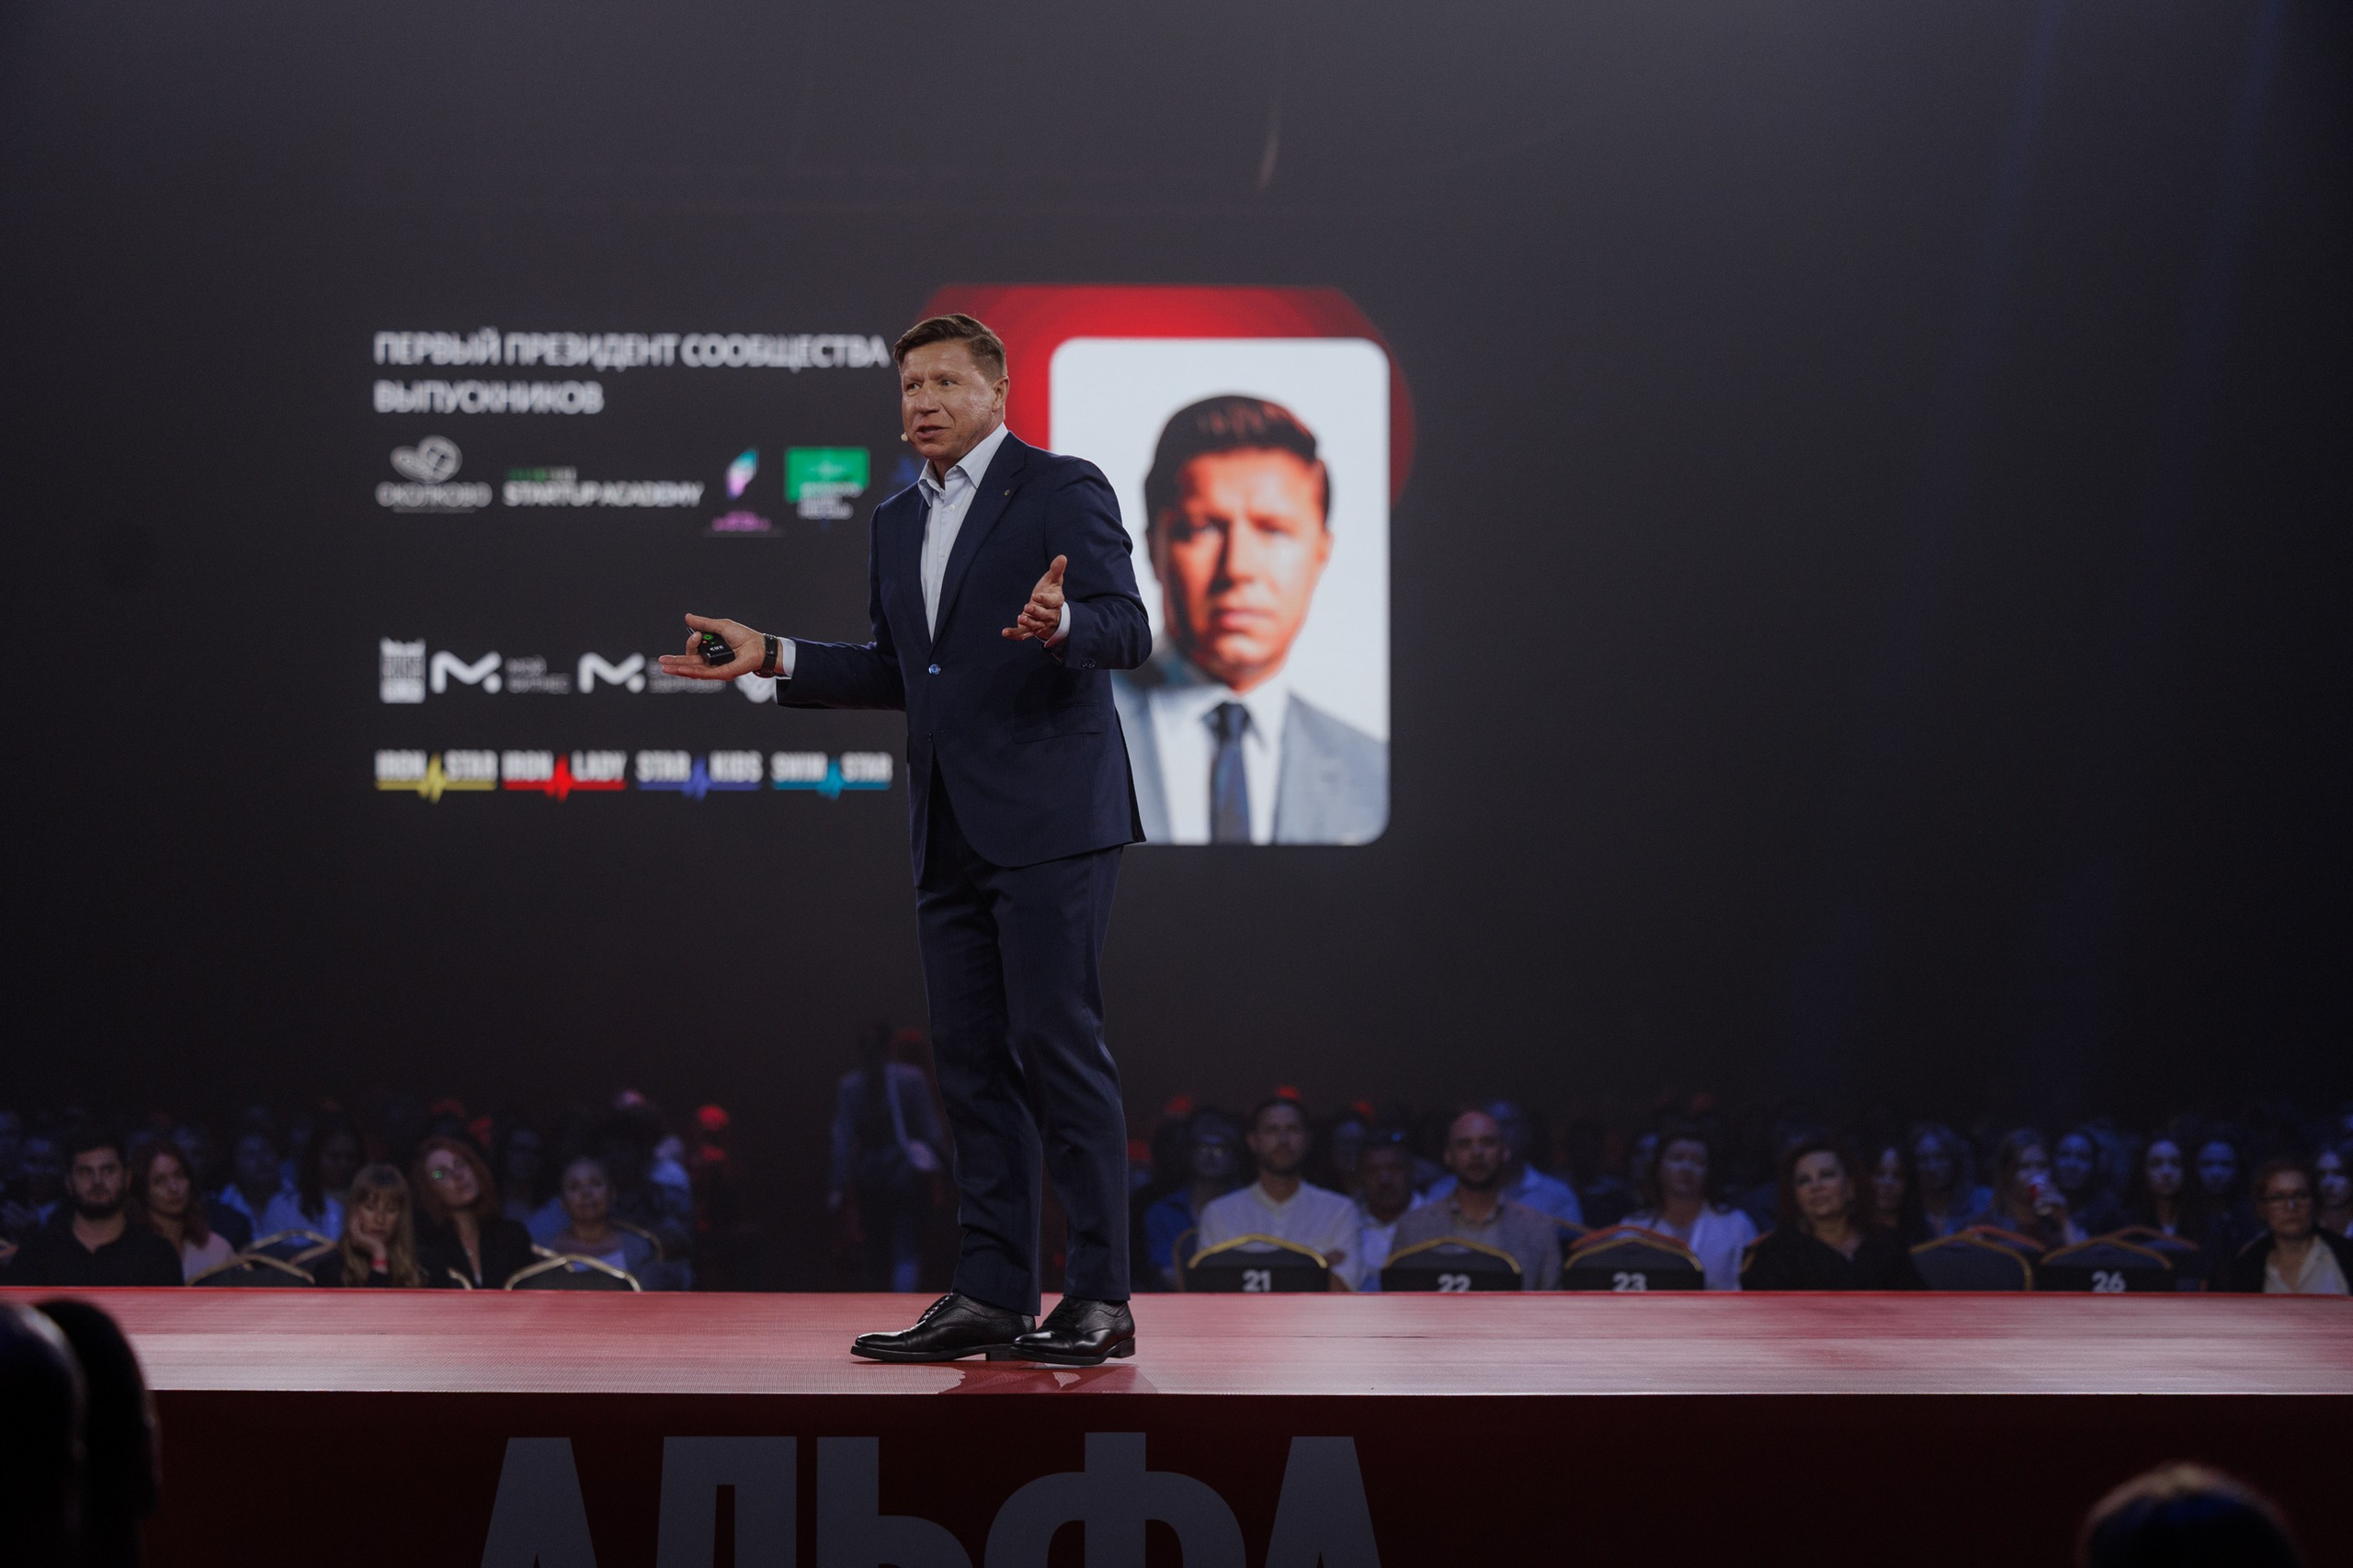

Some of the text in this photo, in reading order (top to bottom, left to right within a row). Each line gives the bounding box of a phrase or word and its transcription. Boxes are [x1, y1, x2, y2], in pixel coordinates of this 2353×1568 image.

[373, 326, 891, 373] ПЕРВЫЙ ПРЕЗИДЕНТ СООБЩЕСТВА
[373, 379, 605, 414] ВЫПУСКНИКОВ
[1242, 1268, 1271, 1292] 21
[1437, 1273, 1472, 1292] 22
[1611, 1271, 1647, 1292] 23
[2091, 1269, 2127, 1292] 26
[480, 1431, 1382, 1568] АЛЬФА
